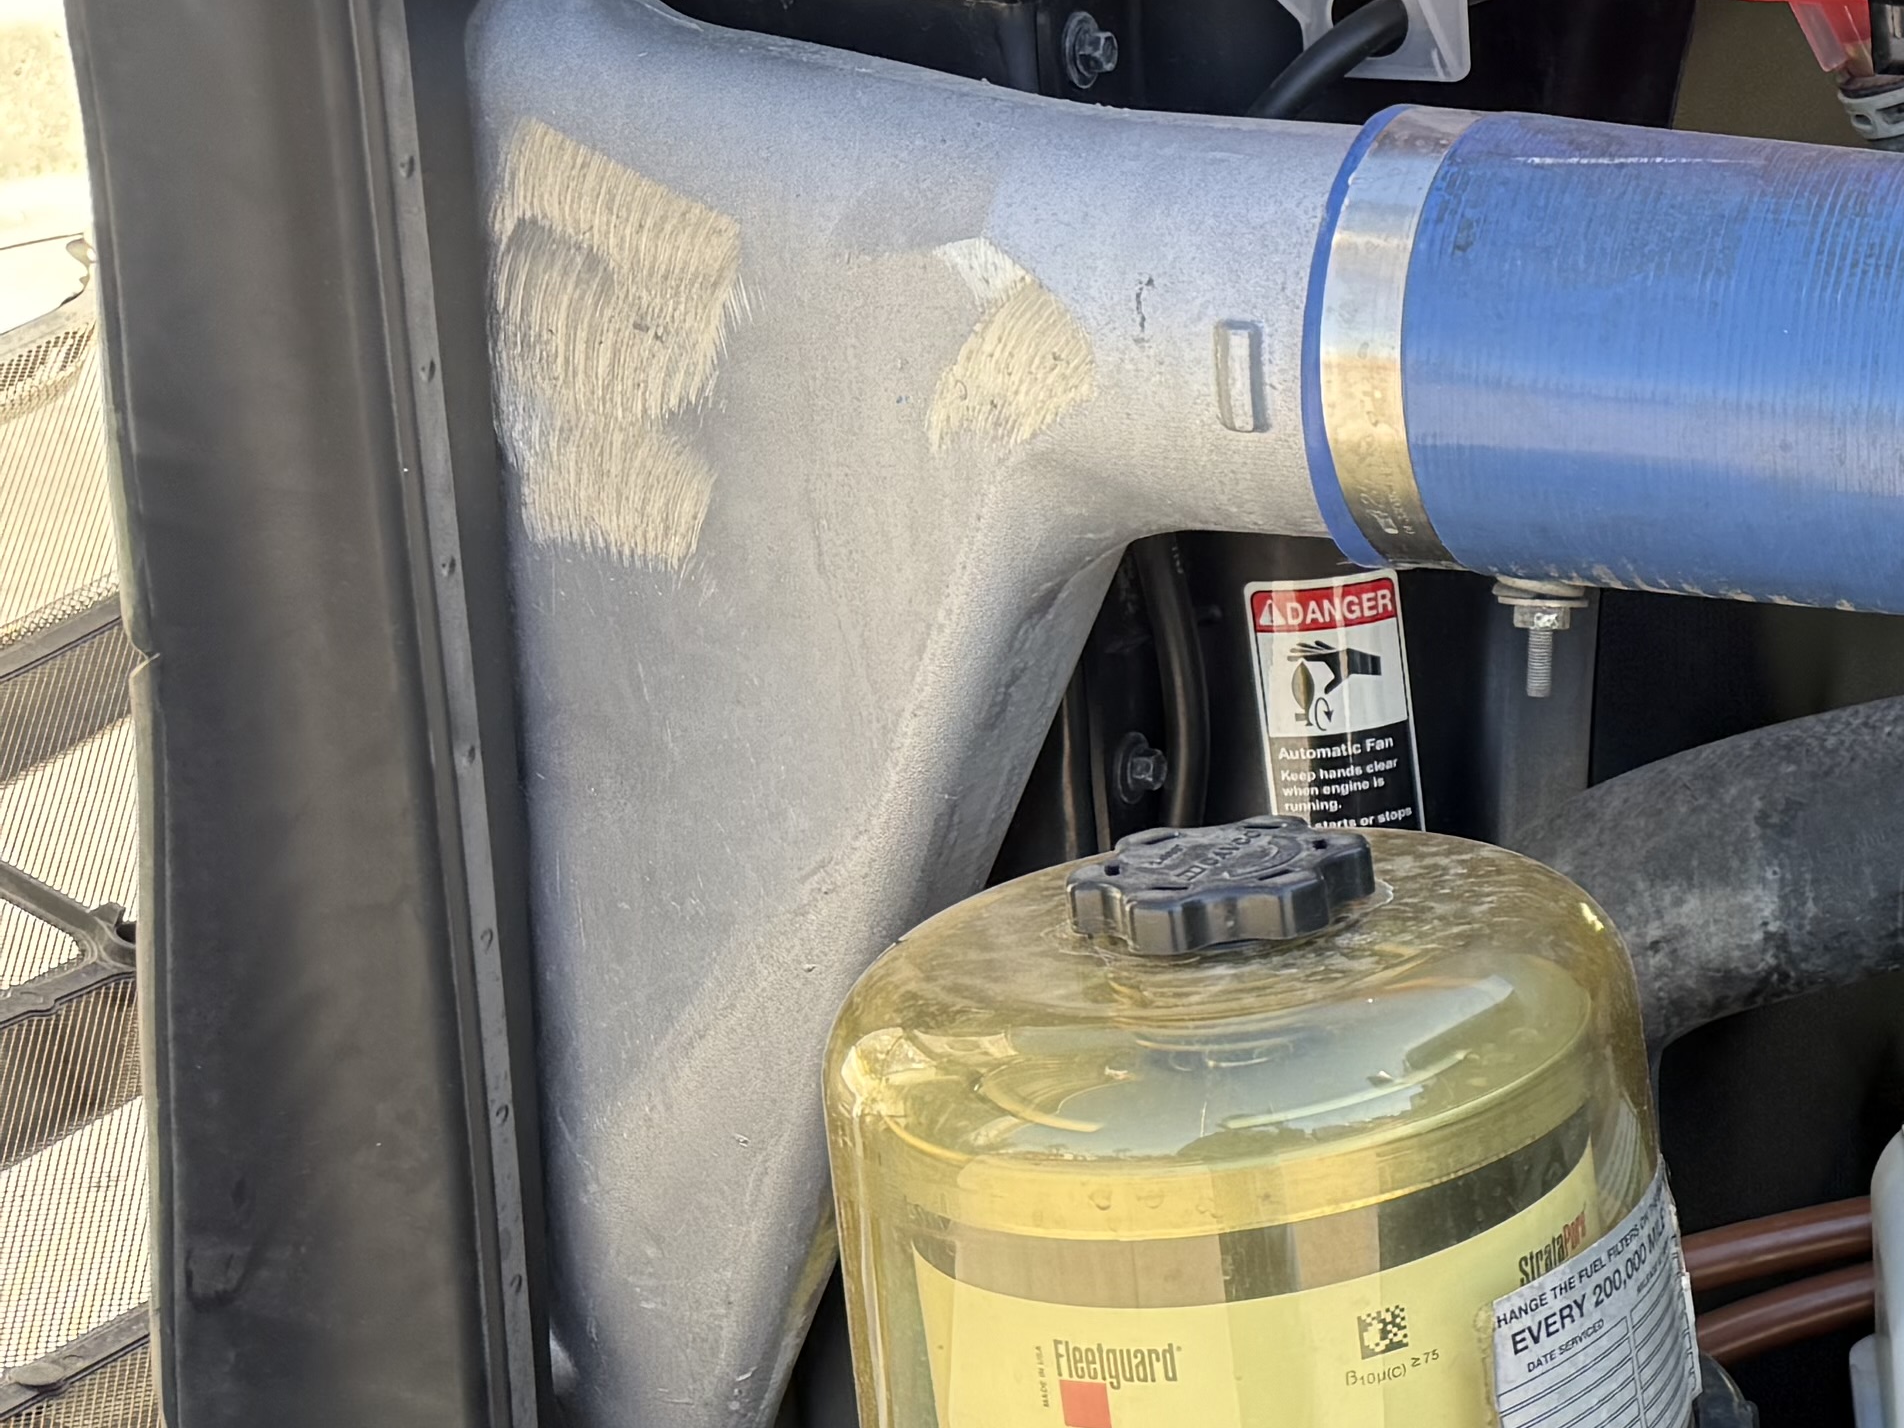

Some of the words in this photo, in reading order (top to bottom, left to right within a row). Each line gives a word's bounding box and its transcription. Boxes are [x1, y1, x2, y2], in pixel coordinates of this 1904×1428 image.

[1286, 589, 1393, 625] DANGER
[1278, 741, 1362, 760] Automatic
[1365, 736, 1394, 753] Fan
[1281, 768, 1317, 784] Keep
[1319, 763, 1363, 780] hands
[1365, 757, 1399, 773] clear
[1283, 784, 1320, 797] when
[1323, 780, 1370, 798] engine
[1373, 775, 1385, 789] is
[1284, 798, 1342, 814] running.
[1359, 814, 1375, 828] or
[1377, 806, 1413, 825] stops
[1496, 1292, 1549, 1329] HANGE
[1550, 1278, 1576, 1300] THE
[1576, 1257, 1607, 1289] FUEL
[1607, 1223, 1640, 1263] FILTERS
[1509, 1293, 1587, 1357] EVERY
[1592, 1246, 1647, 1310] 200,000
[1527, 1350, 1557, 1373] DATE
[1557, 1318, 1605, 1356] SERVICED
[1053, 1338, 1178, 1391] Fleetguard
[1040, 1381, 1050, 1408] MADE
